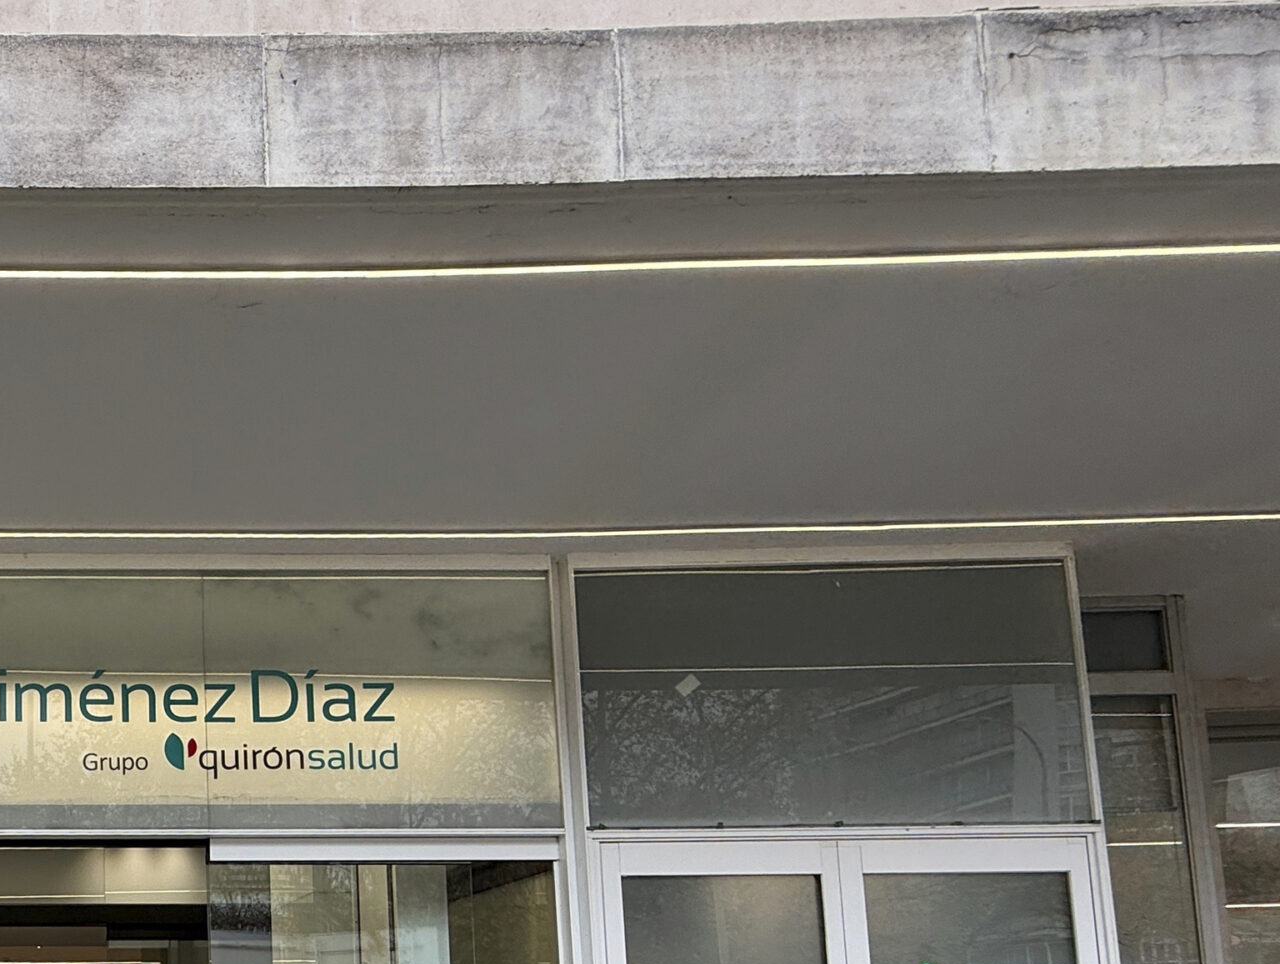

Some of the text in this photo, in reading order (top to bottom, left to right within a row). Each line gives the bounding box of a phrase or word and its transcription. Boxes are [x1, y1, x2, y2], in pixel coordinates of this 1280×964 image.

[250, 668, 396, 723] Díaz
[82, 742, 399, 779] Grupo quirónsalud
